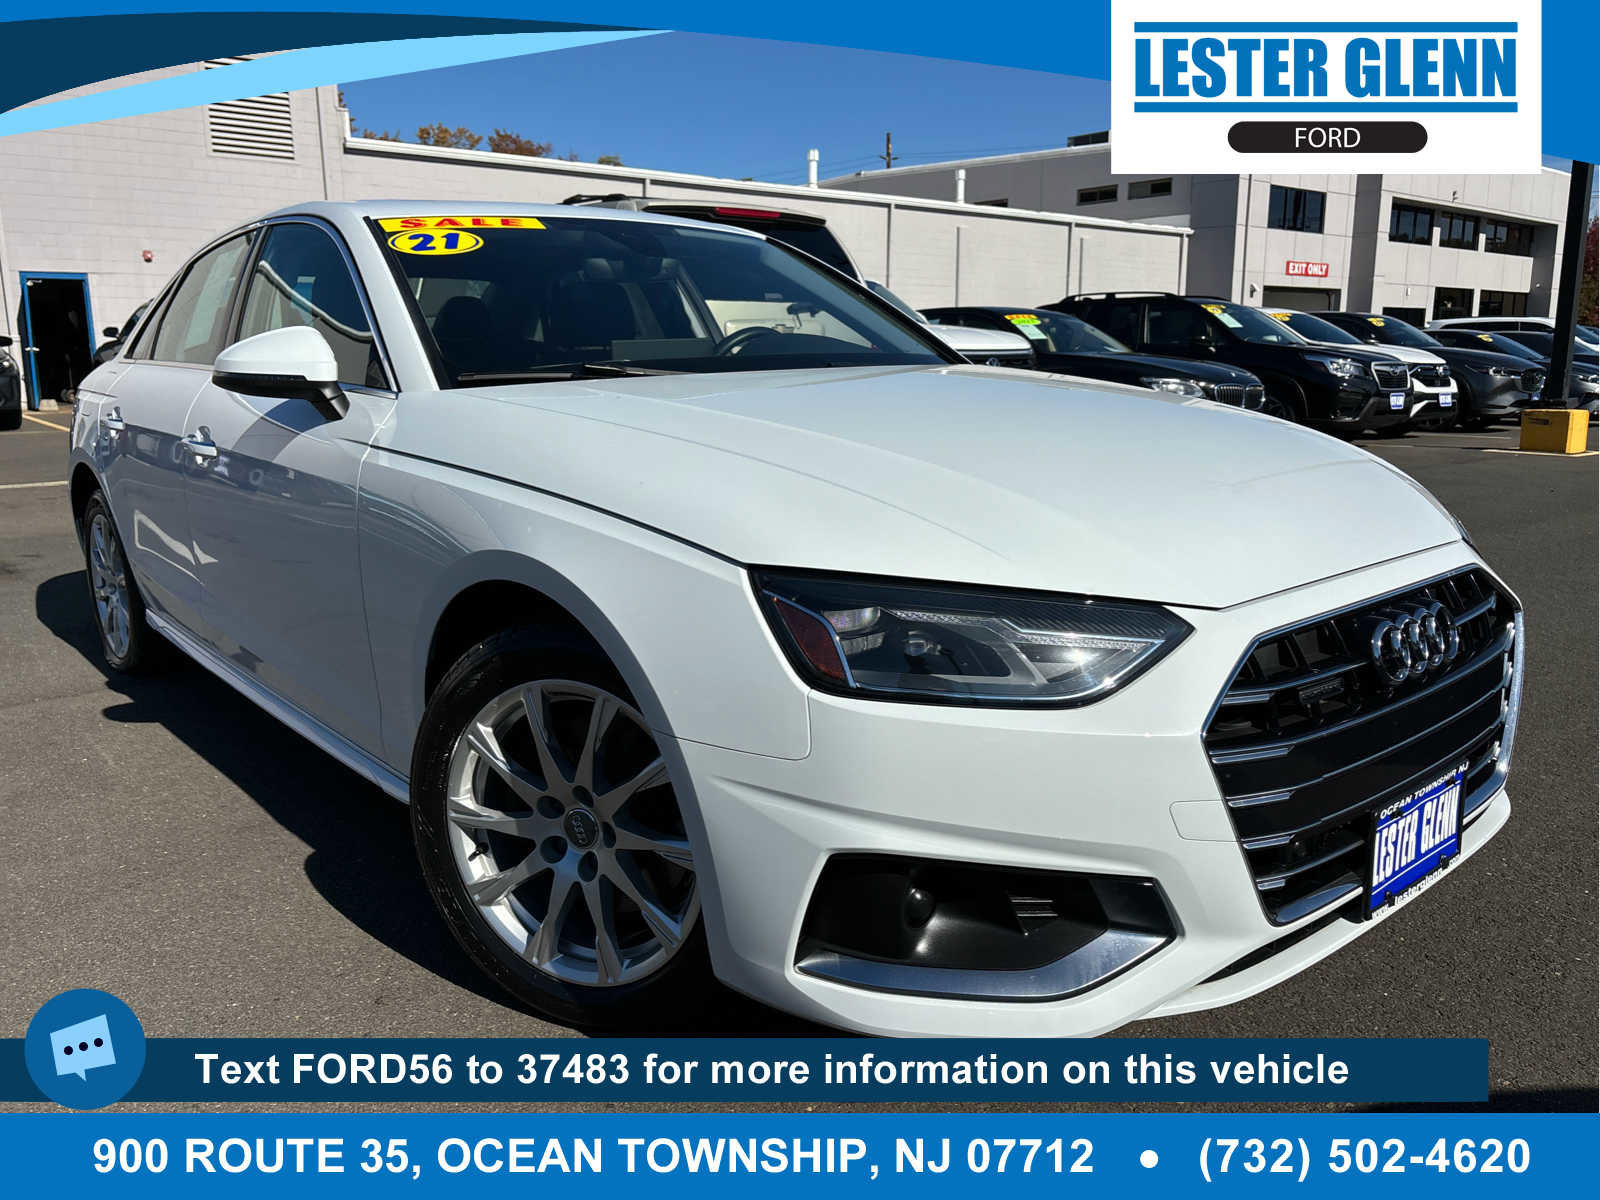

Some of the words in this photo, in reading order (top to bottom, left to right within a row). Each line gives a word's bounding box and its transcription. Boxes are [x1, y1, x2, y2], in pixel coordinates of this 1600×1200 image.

[400, 217, 523, 229] SALE
[408, 233, 460, 251] 21
[1289, 262, 1307, 274] EXIT
[1307, 263, 1327, 275] ONLY
[1380, 794, 1412, 820] OCEAN
[1414, 771, 1457, 799] TOWNSHIP
[1458, 761, 1470, 774] NJ
[1372, 809, 1419, 888] LESTER
[1420, 784, 1461, 855] GLENN
